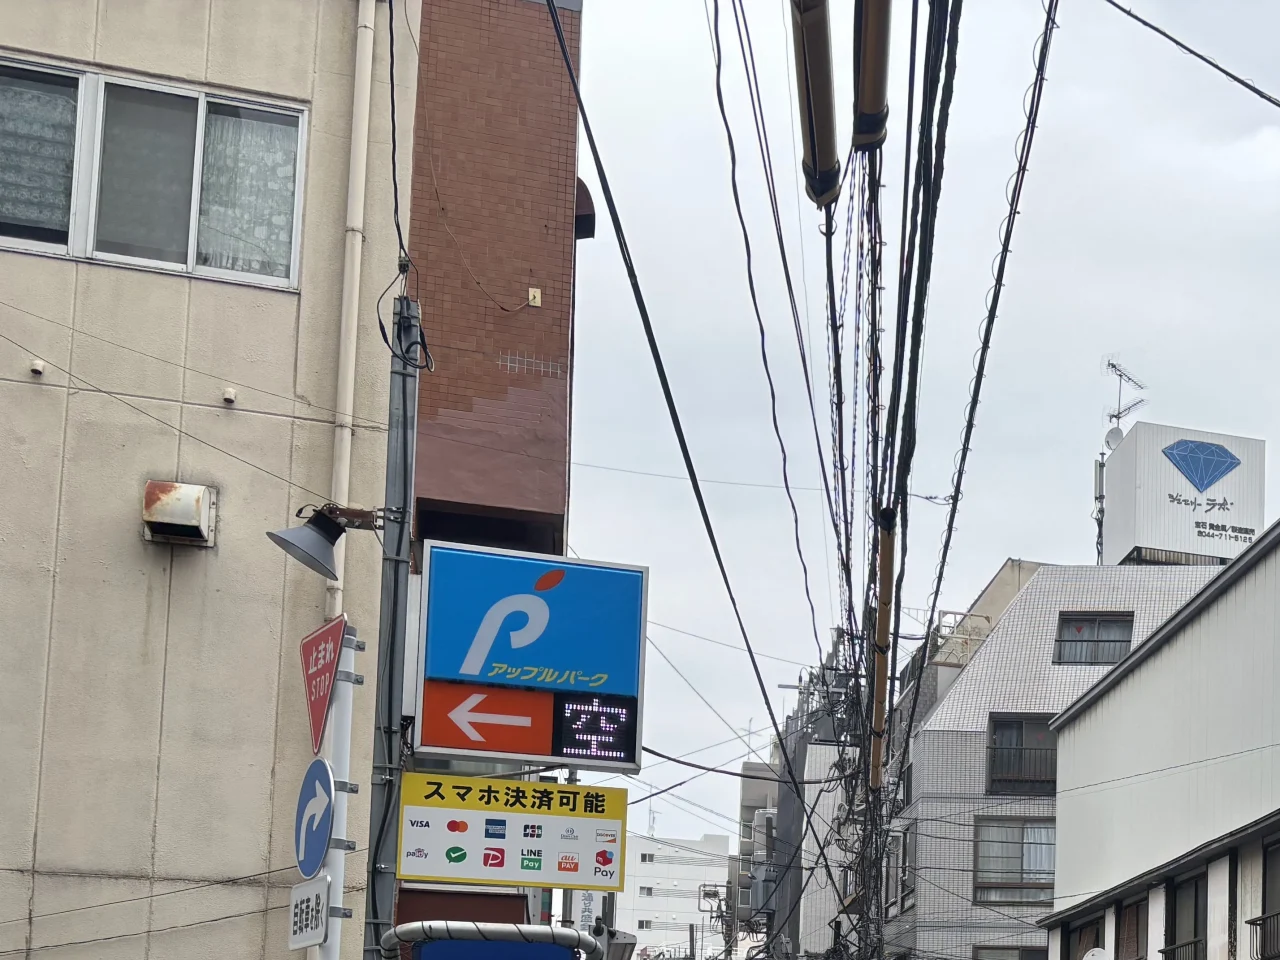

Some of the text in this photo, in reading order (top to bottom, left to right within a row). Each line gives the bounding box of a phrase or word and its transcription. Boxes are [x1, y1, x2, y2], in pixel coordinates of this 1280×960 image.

[308, 636, 335, 675] 止まれ
[311, 672, 330, 701] STOP
[487, 662, 609, 687] アップルパーク
[563, 698, 627, 758] 空
[424, 780, 606, 814] スマホ決済可能
[409, 819, 430, 829] VISA
[521, 848, 543, 858] LINE
[523, 859, 540, 869] Pay
[593, 866, 615, 880] Pay
[292, 892, 325, 936] 自転車を除く
